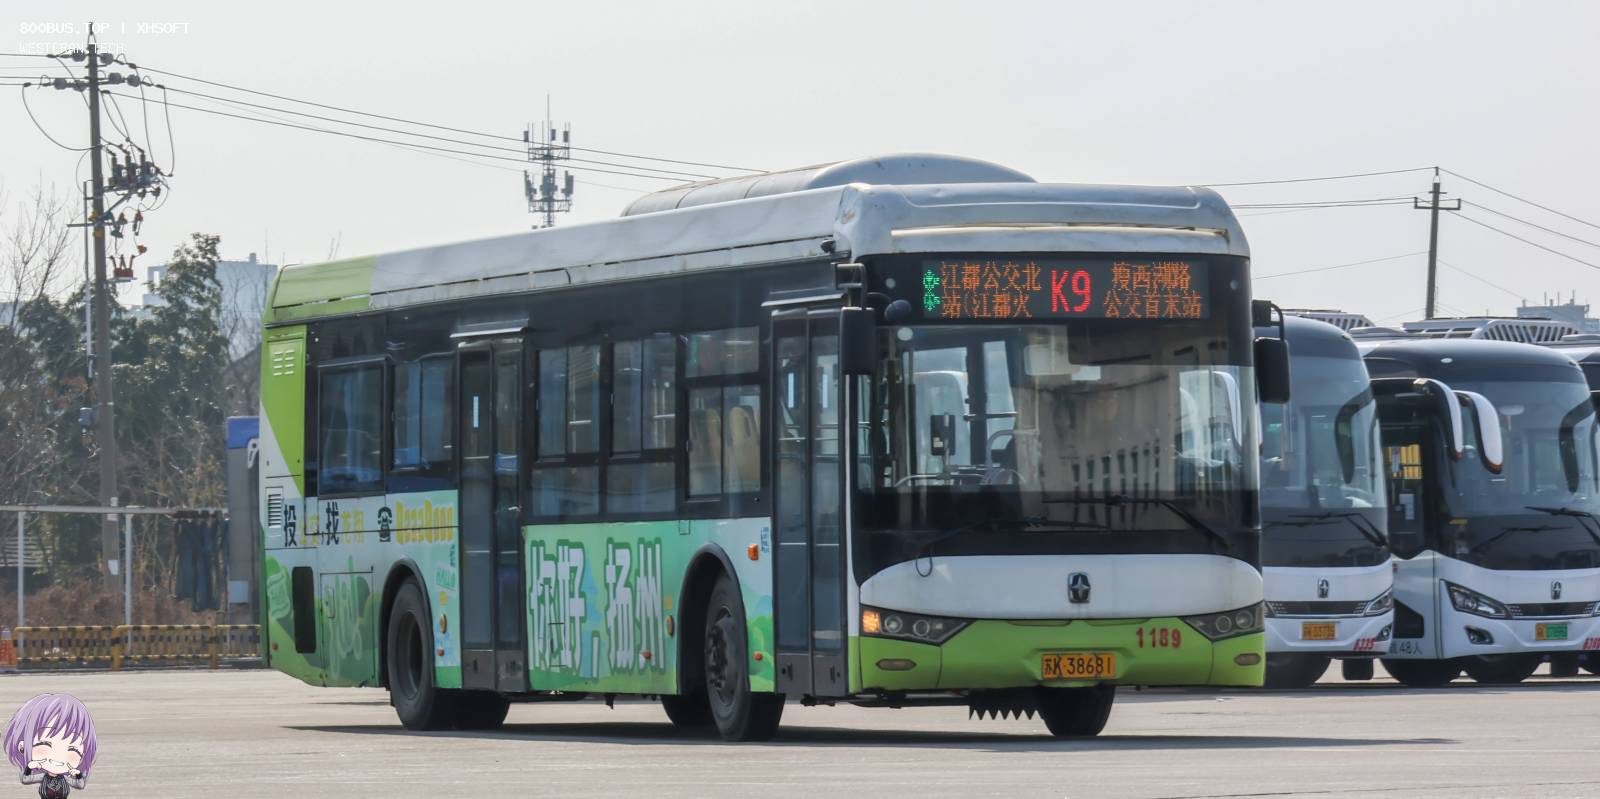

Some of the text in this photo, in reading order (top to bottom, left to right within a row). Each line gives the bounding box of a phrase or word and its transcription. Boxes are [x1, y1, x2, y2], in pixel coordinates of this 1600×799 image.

[941, 261, 1042, 291] 江都公交北
[1051, 268, 1092, 313] K9
[1136, 627, 1182, 648] 1189
